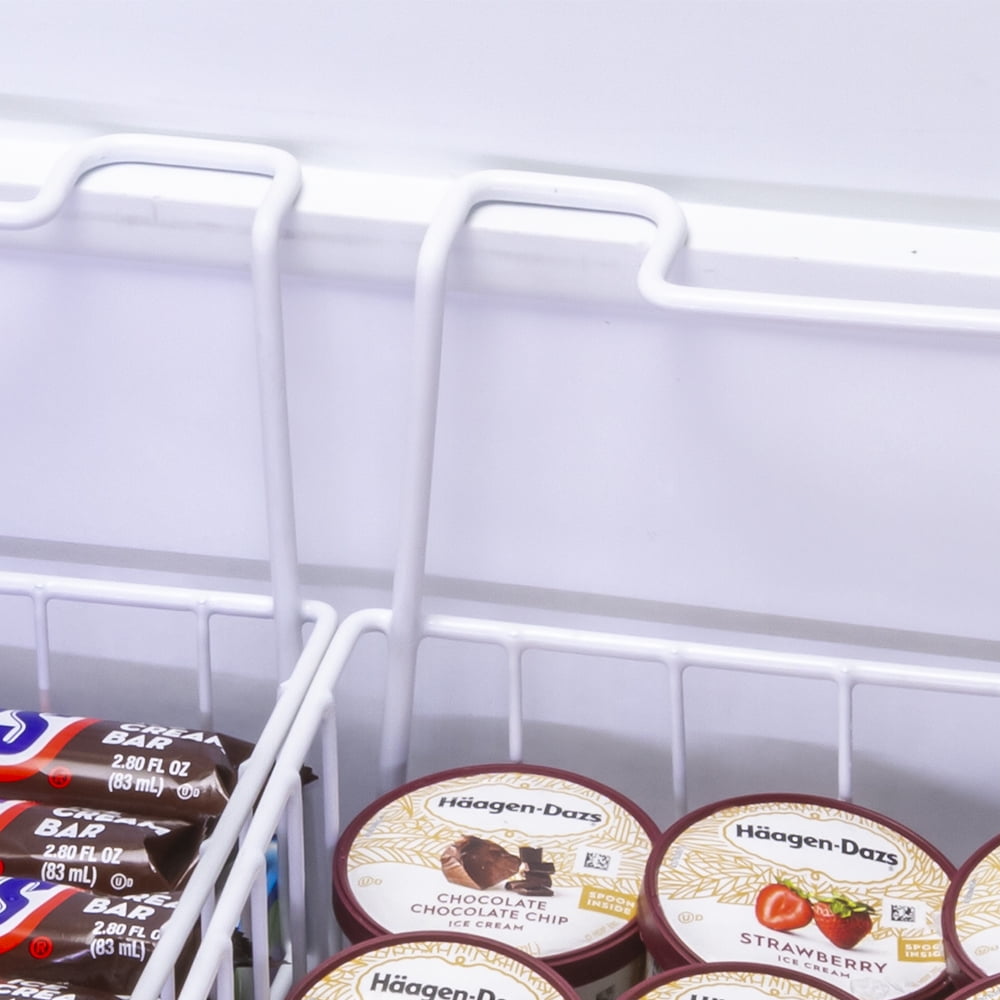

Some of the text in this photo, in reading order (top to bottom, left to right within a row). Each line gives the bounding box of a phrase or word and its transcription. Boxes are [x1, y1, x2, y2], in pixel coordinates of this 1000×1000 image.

[102, 731, 173, 750] BAR
[112, 754, 191, 777] 2.80 FL OZ
[108, 773, 164, 797] (83 mL)
[438, 796, 602, 825] Häagen-Dazs
[34, 818, 105, 838] BAR
[44, 844, 123, 865] 2.80 FL OZ
[736, 823, 899, 866] Häagen-Dazs
[41, 862, 97, 888] (83 mL)
[83, 897, 155, 920] BAR
[437, 893, 547, 911] CHOCOLATE
[586, 898, 632, 915] INSIDE
[588, 890, 636, 907] SPOON
[410, 903, 569, 926] CHOCOLATE CHIP
[92, 921, 146, 939] 2.80 FL
[448, 920, 524, 932] ICE CREAM
[90, 939, 146, 961] (83 mL)
[740, 932, 888, 974] STRAWBERRY
[778, 955, 851, 979] ICE CREAM
